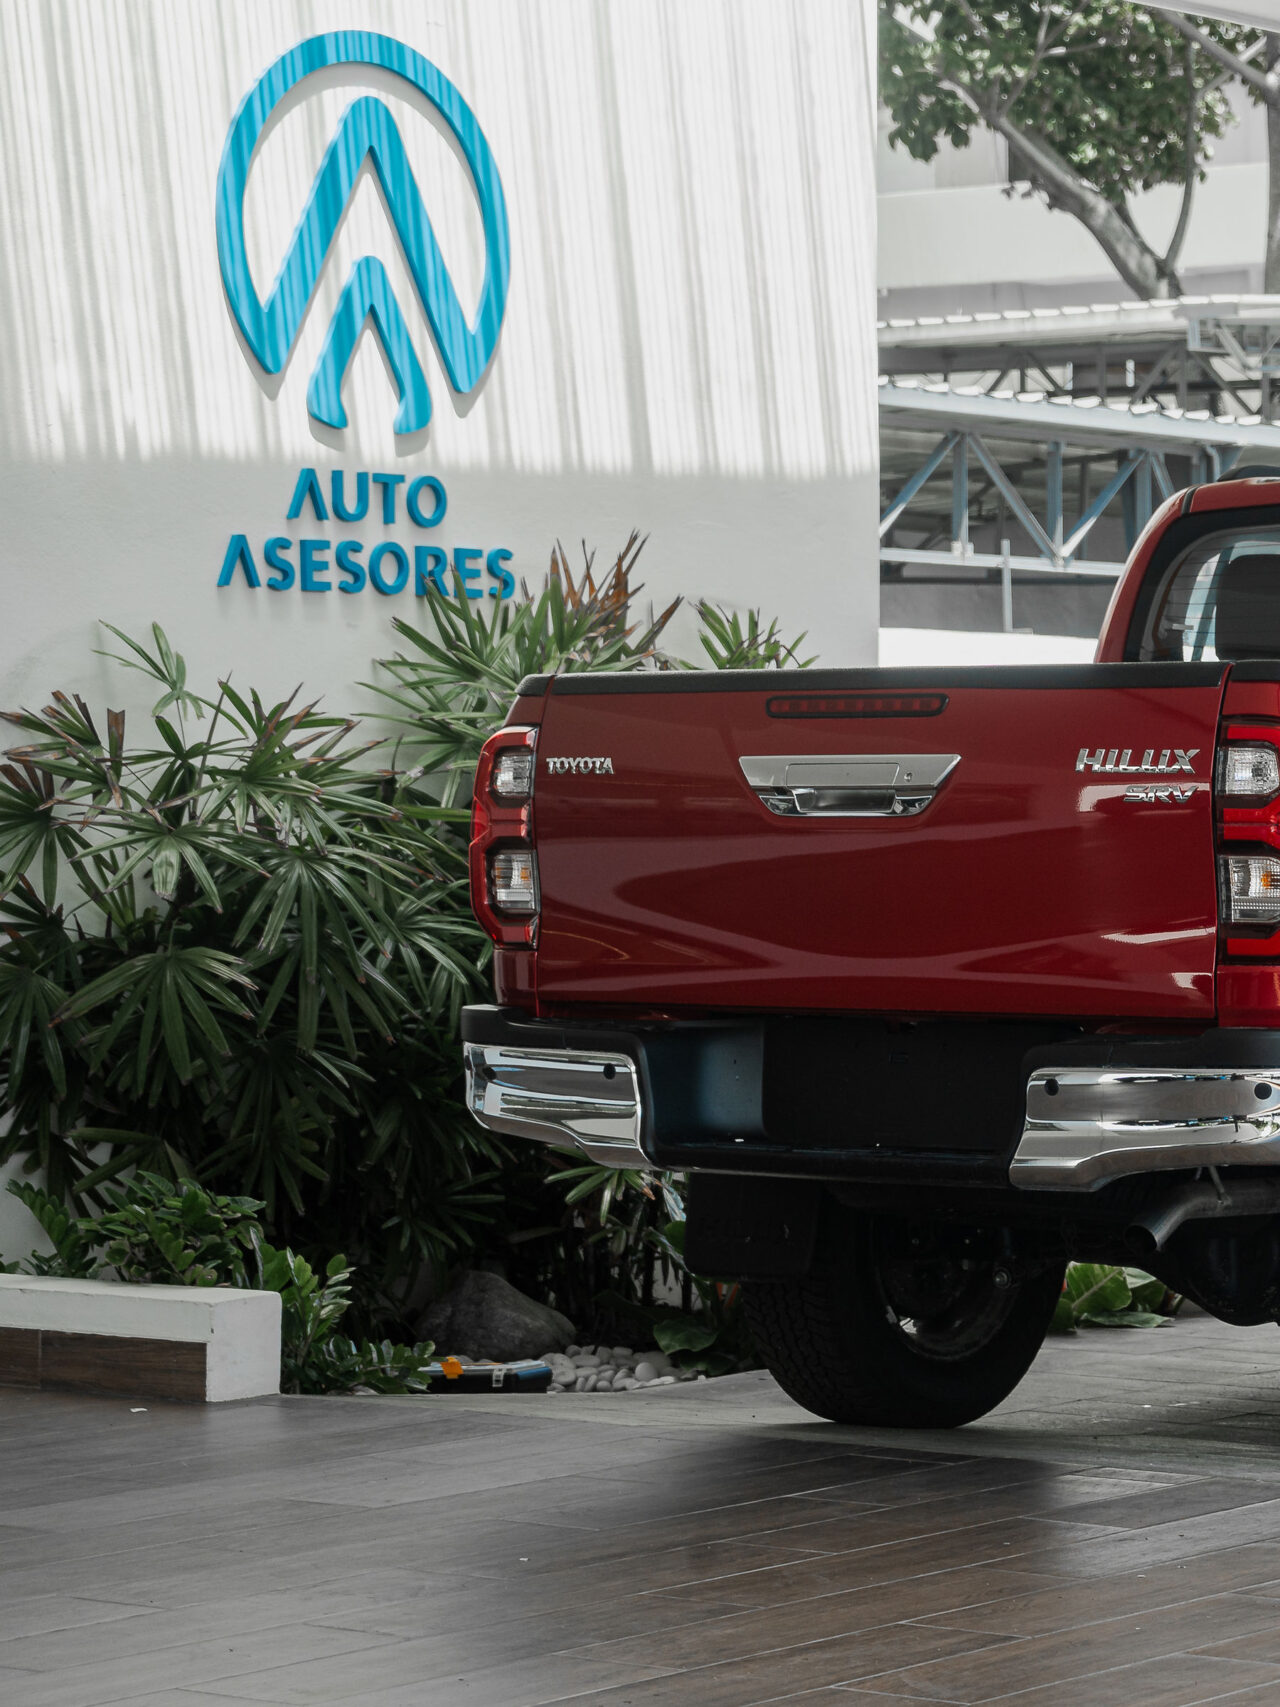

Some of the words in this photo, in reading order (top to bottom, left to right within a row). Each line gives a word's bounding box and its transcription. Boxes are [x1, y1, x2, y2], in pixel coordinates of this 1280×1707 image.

[286, 468, 448, 528] AUTO
[217, 534, 516, 600] ASESORES
[546, 756, 614, 775] TOYOTA
[1075, 748, 1201, 774] HILUX
[1123, 785, 1199, 803] SRV
